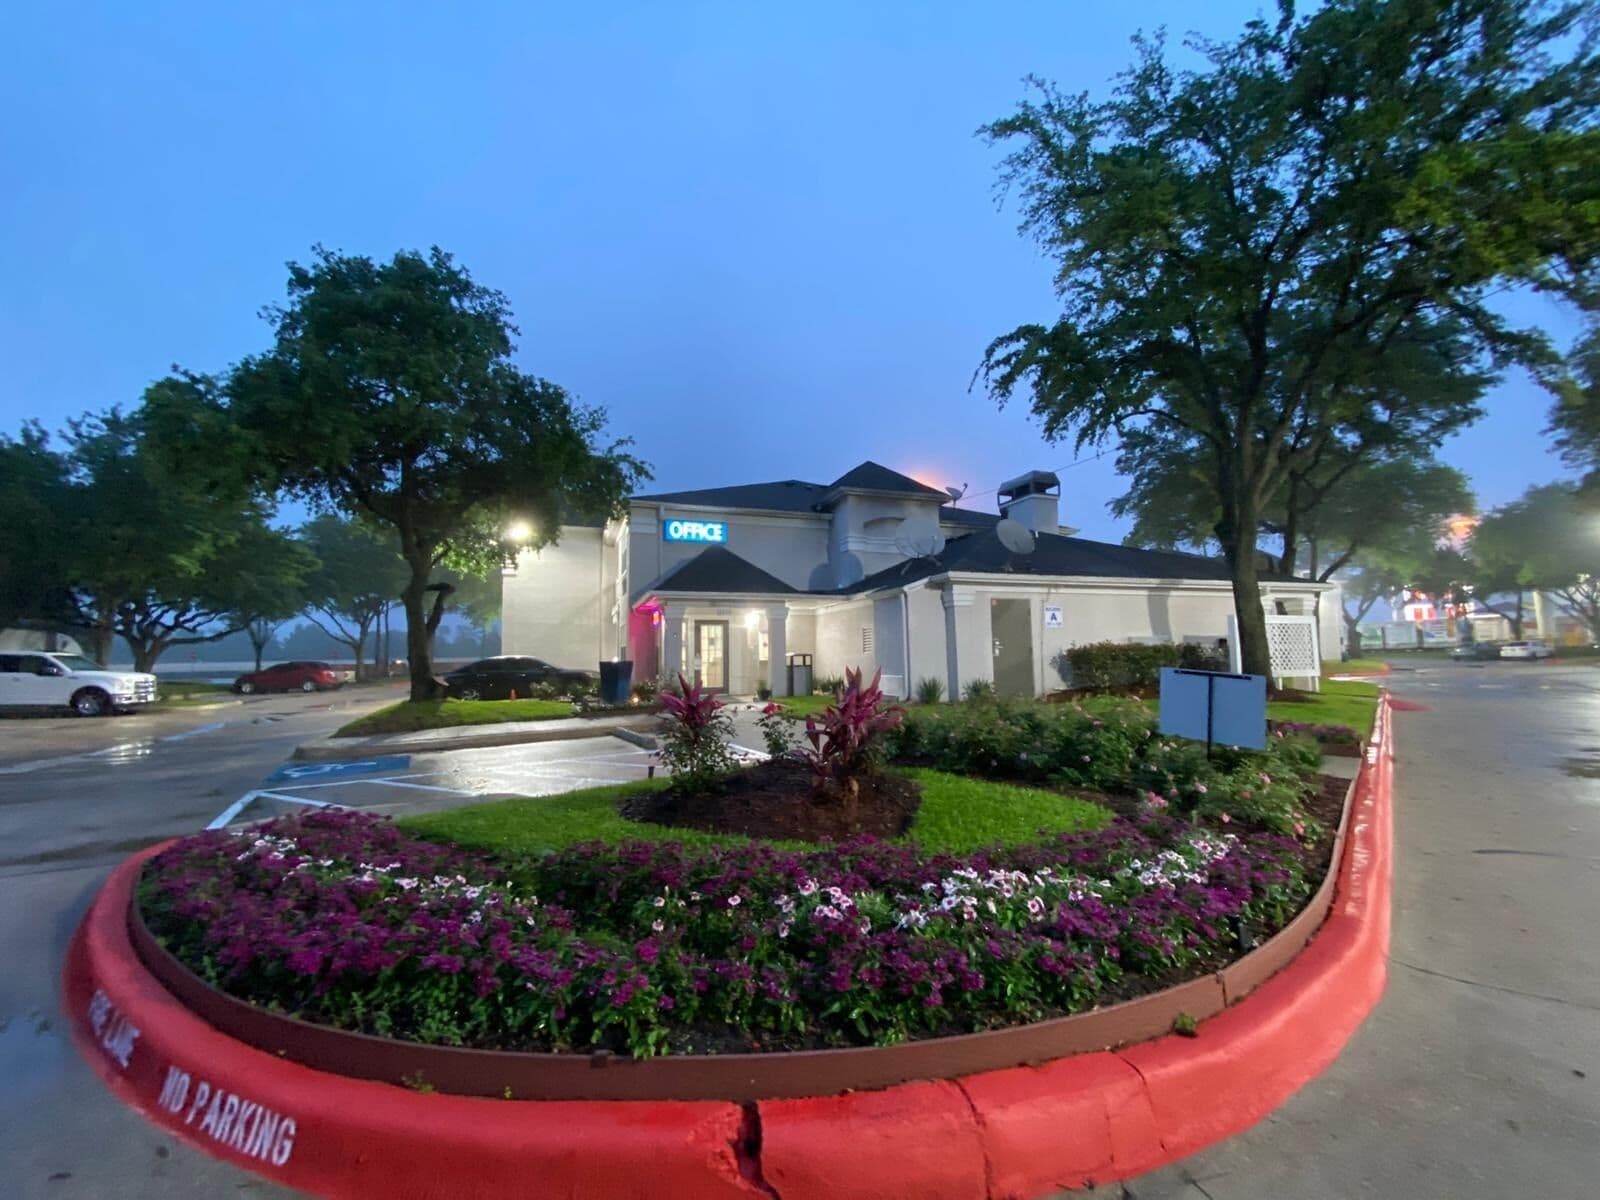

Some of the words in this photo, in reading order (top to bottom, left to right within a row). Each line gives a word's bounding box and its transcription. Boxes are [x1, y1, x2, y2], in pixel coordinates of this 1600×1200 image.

[669, 521, 722, 541] OFFICE
[158, 1064, 190, 1113] NO
[184, 1080, 297, 1166] PARKING
